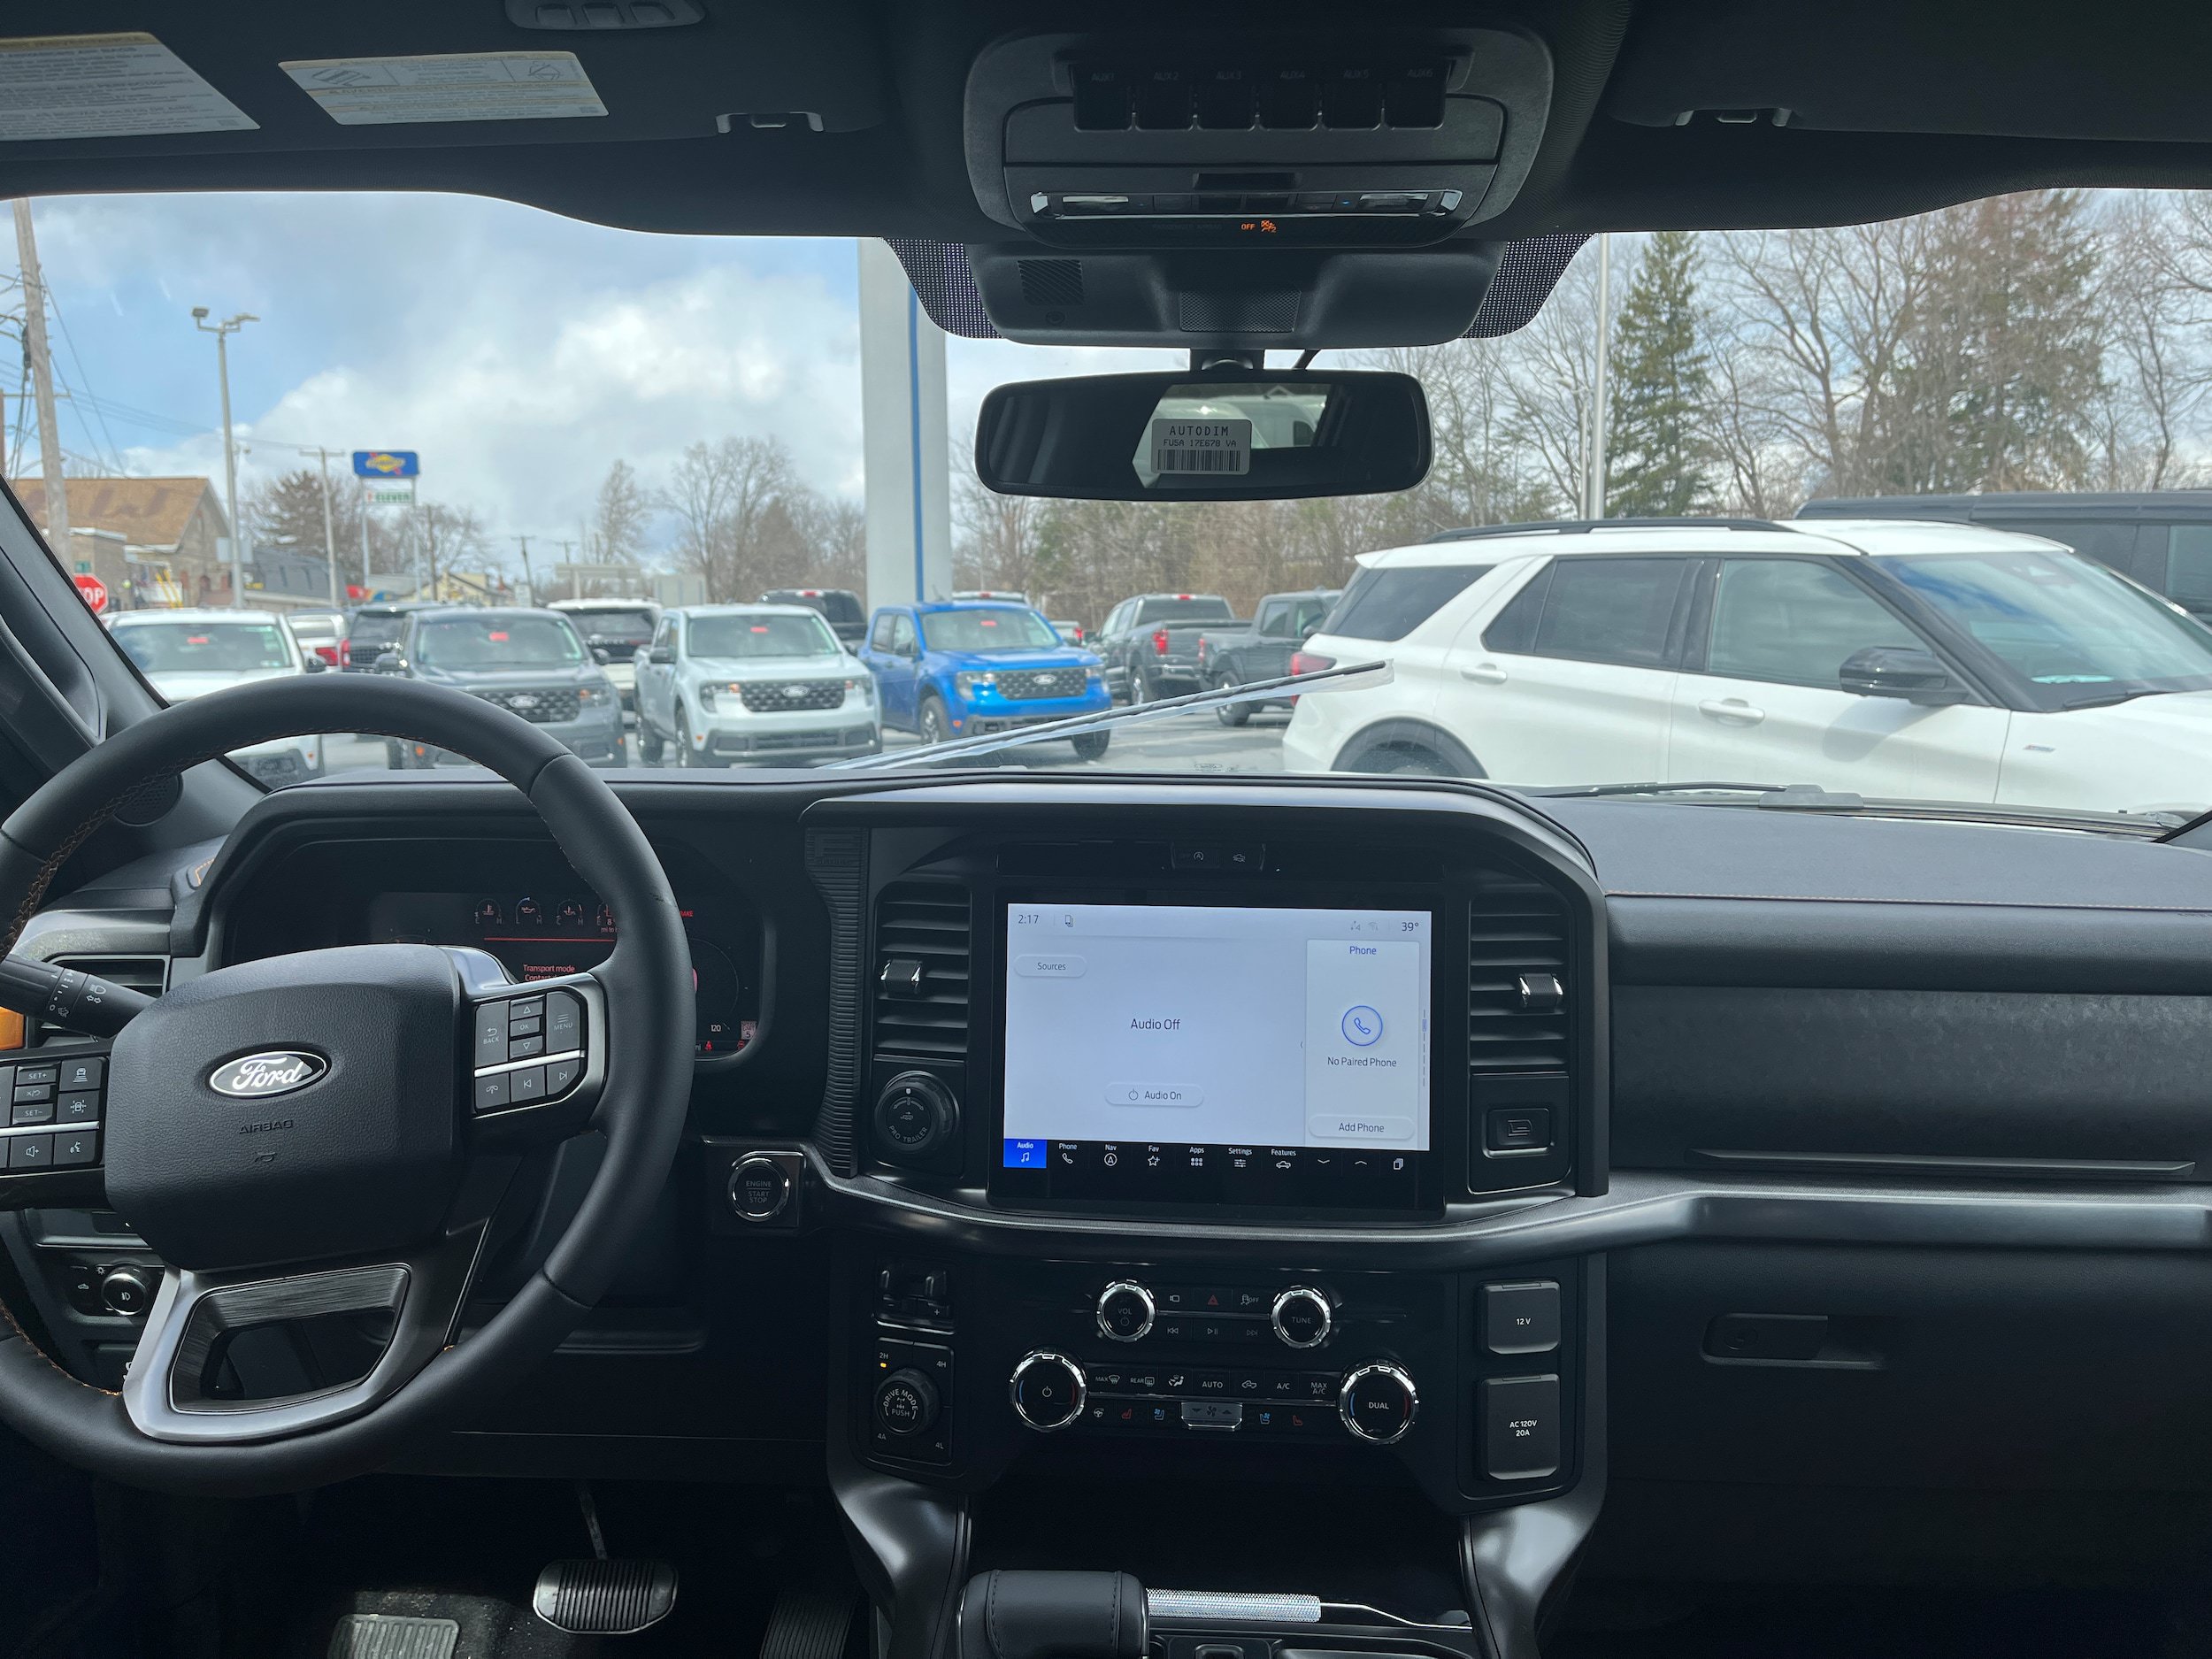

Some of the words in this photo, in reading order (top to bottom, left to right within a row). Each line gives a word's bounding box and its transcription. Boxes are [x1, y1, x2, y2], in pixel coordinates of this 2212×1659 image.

[1169, 426, 1229, 436] AUTODIM
[1018, 914, 1040, 925] 2:17
[1402, 922, 1419, 932] 39°
[1349, 946, 1377, 955] Phone
[523, 964, 555, 973] Transport
[1037, 961, 1066, 971] Sources
[710, 1024, 722, 1033] 120
[1131, 1018, 1161, 1030] Audio
[1164, 1018, 1180, 1030] Off
[1327, 1056, 1340, 1065] No
[1341, 1056, 1368, 1066] Paired
[1370, 1057, 1397, 1067] Phone
[232, 1057, 304, 1090] Ford
[1144, 1091, 1169, 1100] Audio
[1170, 1091, 1182, 1100] On
[239, 1119, 294, 1134] AIRBAG
[1338, 1122, 1356, 1132] Add
[1357, 1123, 1385, 1133] Phone
[888, 1125, 901, 1140] PRO
[902, 1126, 928, 1143] TRAILER
[1189, 1146, 1205, 1155] Apps
[1228, 1147, 1253, 1156] Settings
[1291, 1316, 1312, 1325] TUNE
[883, 1388, 900, 1408] DRIVE
[901, 1389, 918, 1410] MODE
[891, 1408, 910, 1417] PUSH
[934, 1441, 945, 1450] 4L
